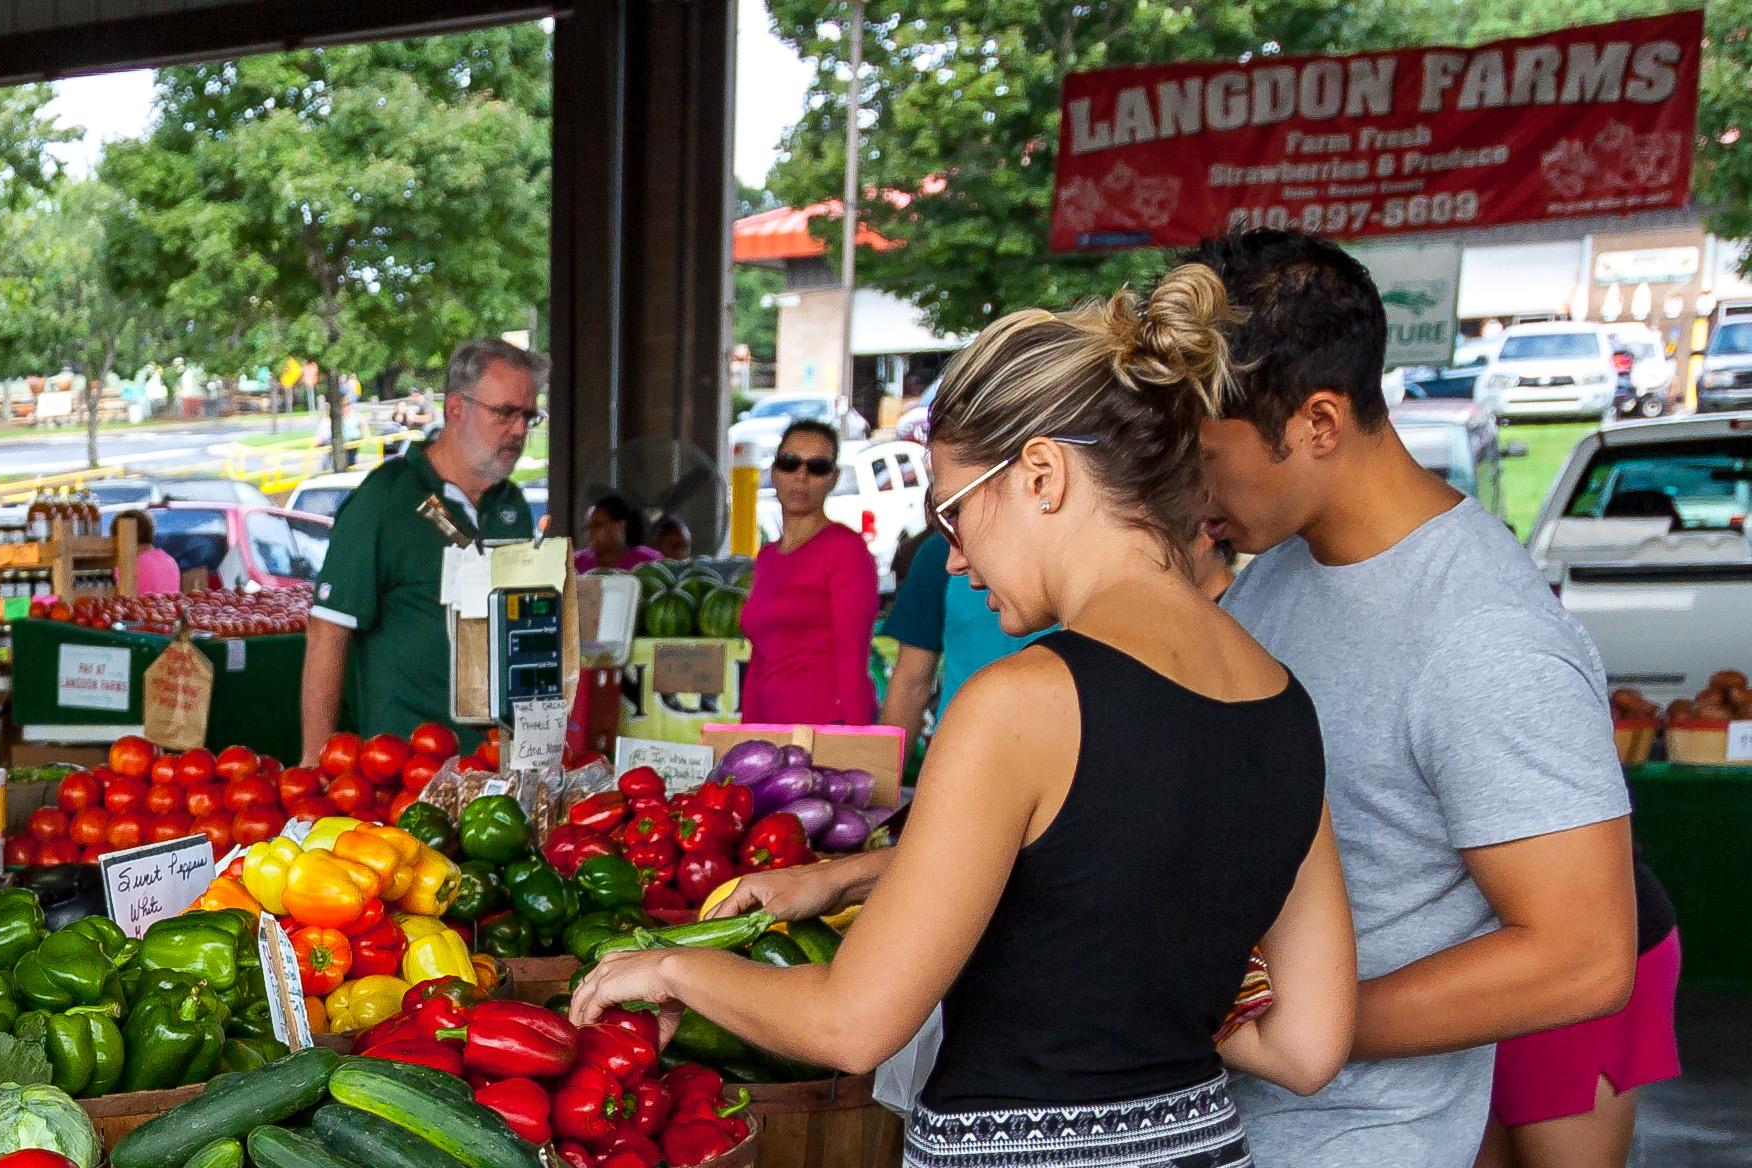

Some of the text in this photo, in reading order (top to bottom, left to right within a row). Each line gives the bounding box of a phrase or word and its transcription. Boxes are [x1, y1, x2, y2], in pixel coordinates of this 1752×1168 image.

[1068, 41, 1682, 156] LANGDON FARMS
[1286, 123, 1432, 154] Farm Fresh
[1209, 157, 1370, 187] Strawberries
[1403, 144, 1510, 174] Produce
[117, 867, 162, 892] Sweet
[130, 895, 162, 923] White
